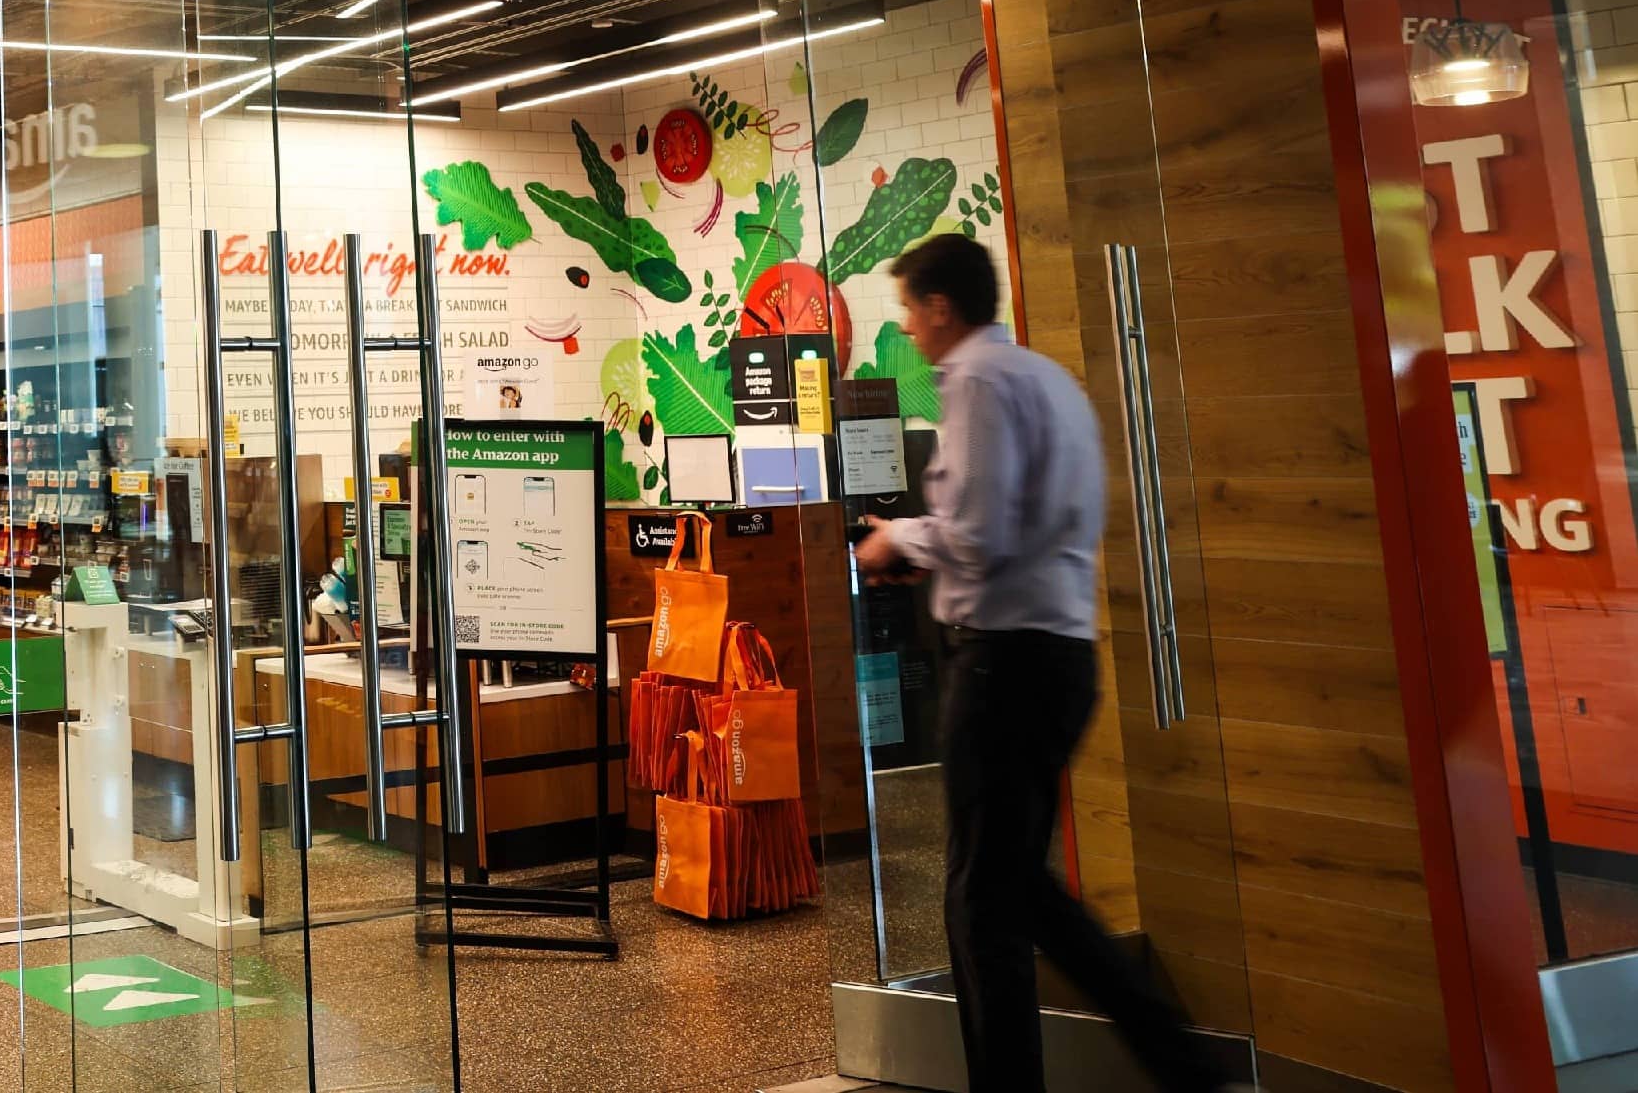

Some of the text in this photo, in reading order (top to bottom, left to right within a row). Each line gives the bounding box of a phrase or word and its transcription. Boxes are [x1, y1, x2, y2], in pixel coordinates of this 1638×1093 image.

[218, 233, 511, 298] Eat well rigt now.
[225, 299, 268, 313] MAYBE
[446, 298, 507, 312] SANDWICH
[458, 331, 510, 348] SALAD
[477, 358, 539, 372] amazon go
[227, 372, 262, 386] EVEN
[314, 370, 340, 384] IT'S
[392, 370, 420, 383] DRIN
[745, 377, 772, 387] package
[749, 386, 771, 395] return
[308, 408, 335, 420] YOU
[338, 406, 388, 420] SHULD
[443, 403, 463, 416] ORE
[476, 430, 490, 441] to
[493, 431, 530, 442] enter
[533, 430, 565, 443] with
[447, 447, 559, 464] the Amazon app
[649, 526, 677, 535] Assistan
[652, 537, 676, 546] Availab
[655, 586, 672, 657] amazon go
[731, 709, 743, 785] amazon go
